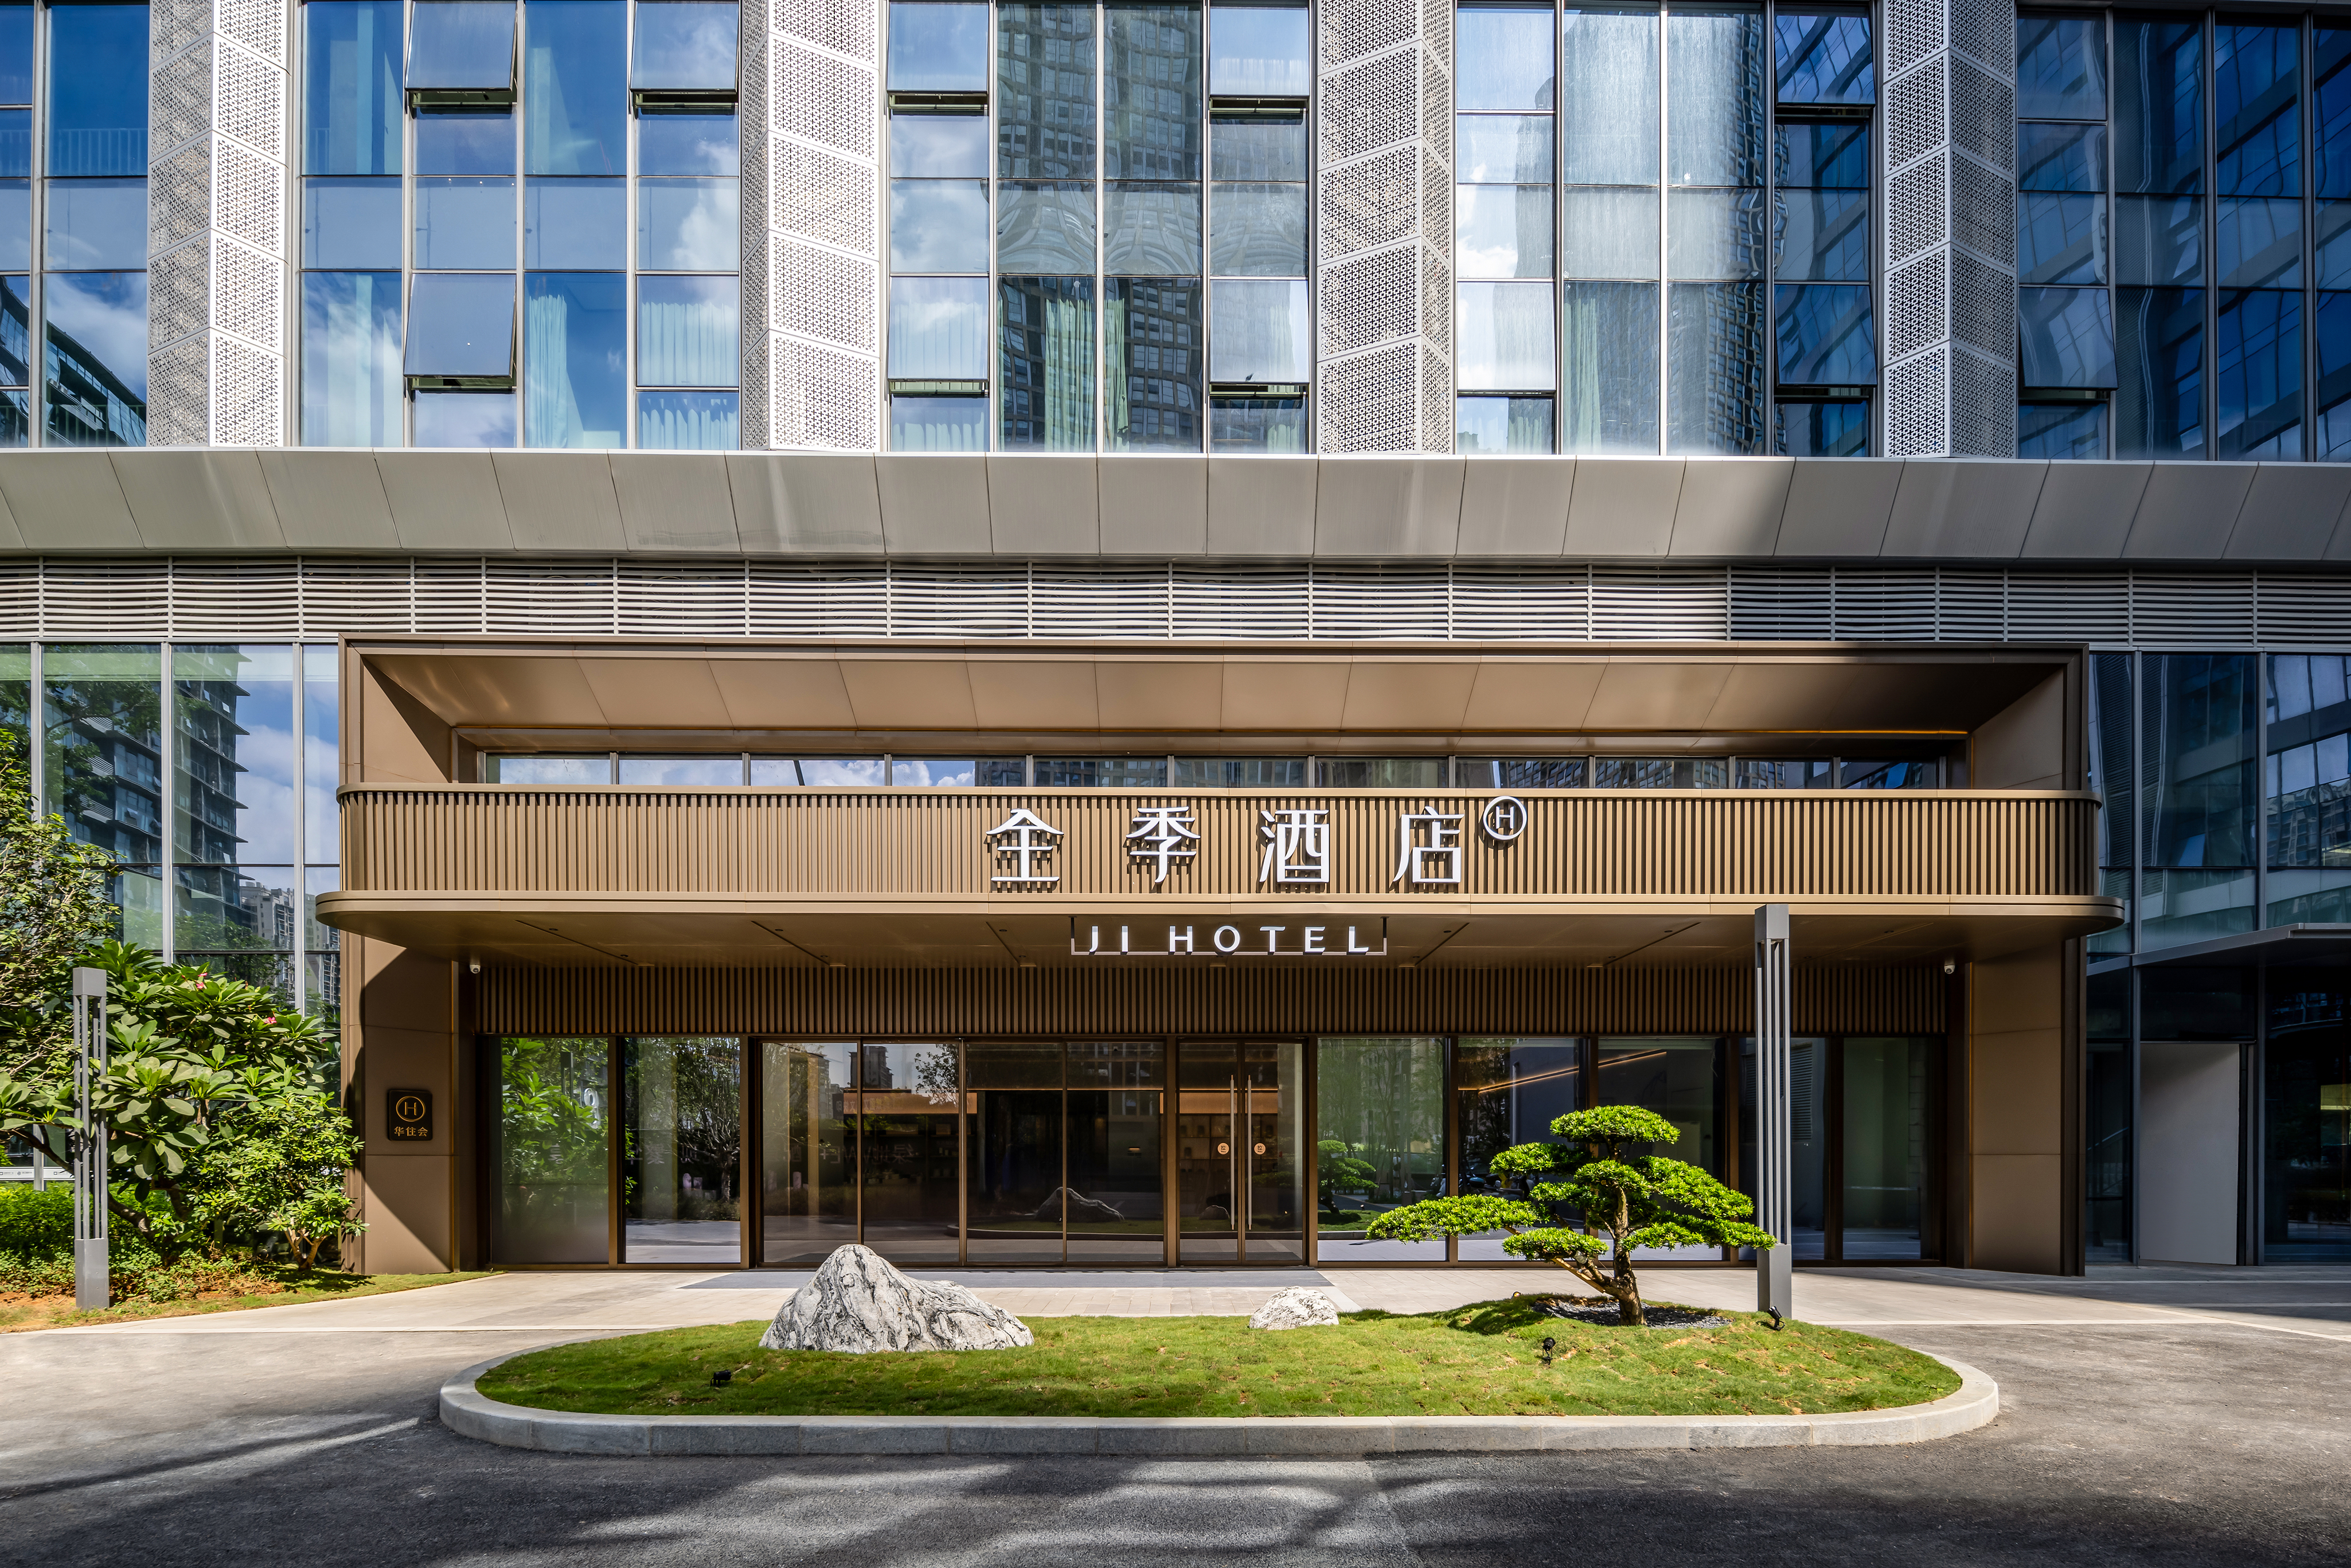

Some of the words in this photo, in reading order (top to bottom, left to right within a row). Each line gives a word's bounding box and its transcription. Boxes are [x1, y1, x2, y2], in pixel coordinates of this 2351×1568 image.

[985, 805, 1465, 883] 全季酒店
[1089, 925, 1128, 953] JI
[1169, 925, 1369, 953] HOTEL
[394, 1126, 428, 1137] 华住会
